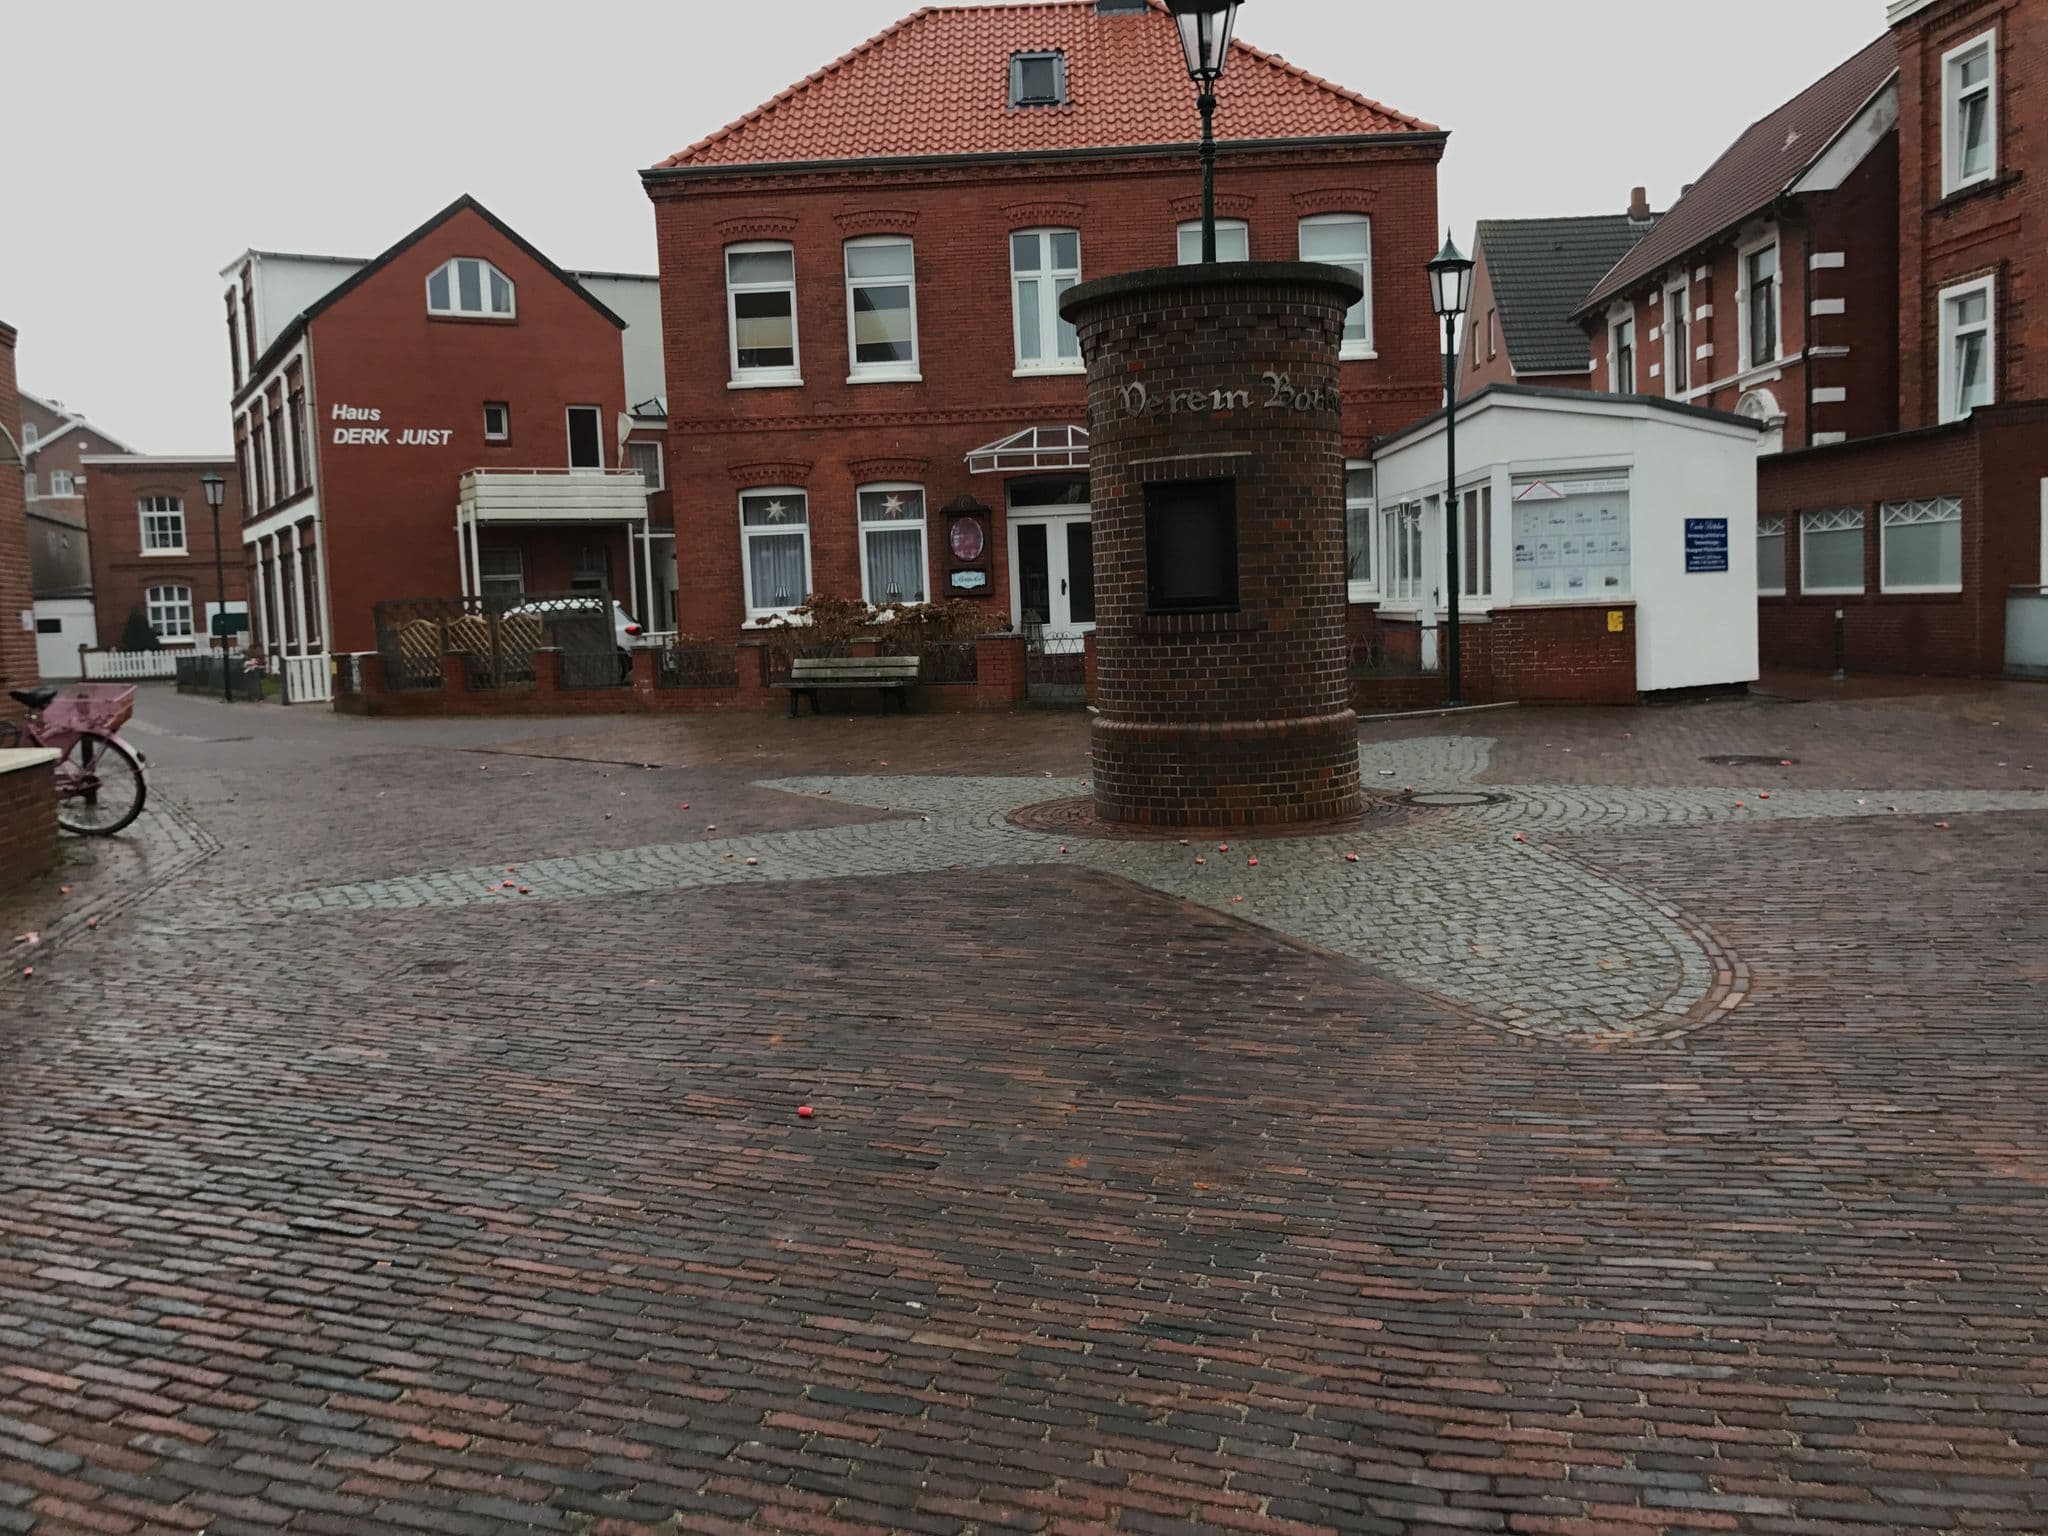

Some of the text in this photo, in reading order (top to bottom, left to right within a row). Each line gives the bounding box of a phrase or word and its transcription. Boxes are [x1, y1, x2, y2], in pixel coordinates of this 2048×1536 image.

[1118, 381, 1254, 418] Verein
[332, 403, 381, 421] Haus
[333, 428, 452, 445] DERK JUIST
